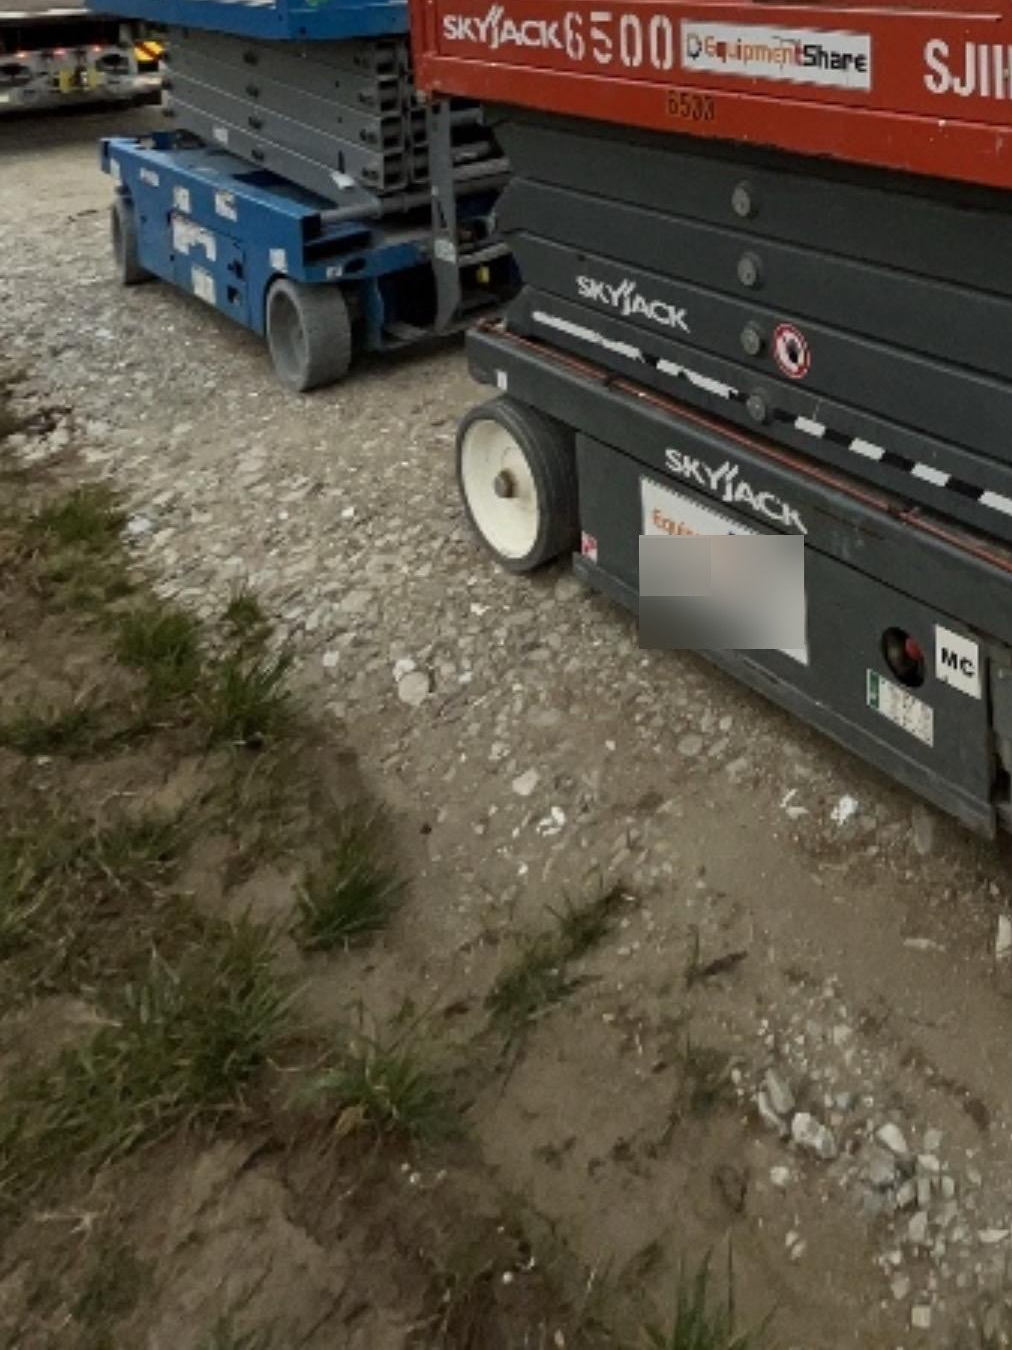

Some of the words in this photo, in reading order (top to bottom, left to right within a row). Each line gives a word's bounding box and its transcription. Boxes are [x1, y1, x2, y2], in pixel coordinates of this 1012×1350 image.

[442, 4, 564, 50] SKYJACK
[563, 10, 676, 71] 6500
[575, 274, 692, 334] SKYJACK
[664, 447, 809, 535] SKYJACK
[940, 646, 976, 679] MC
